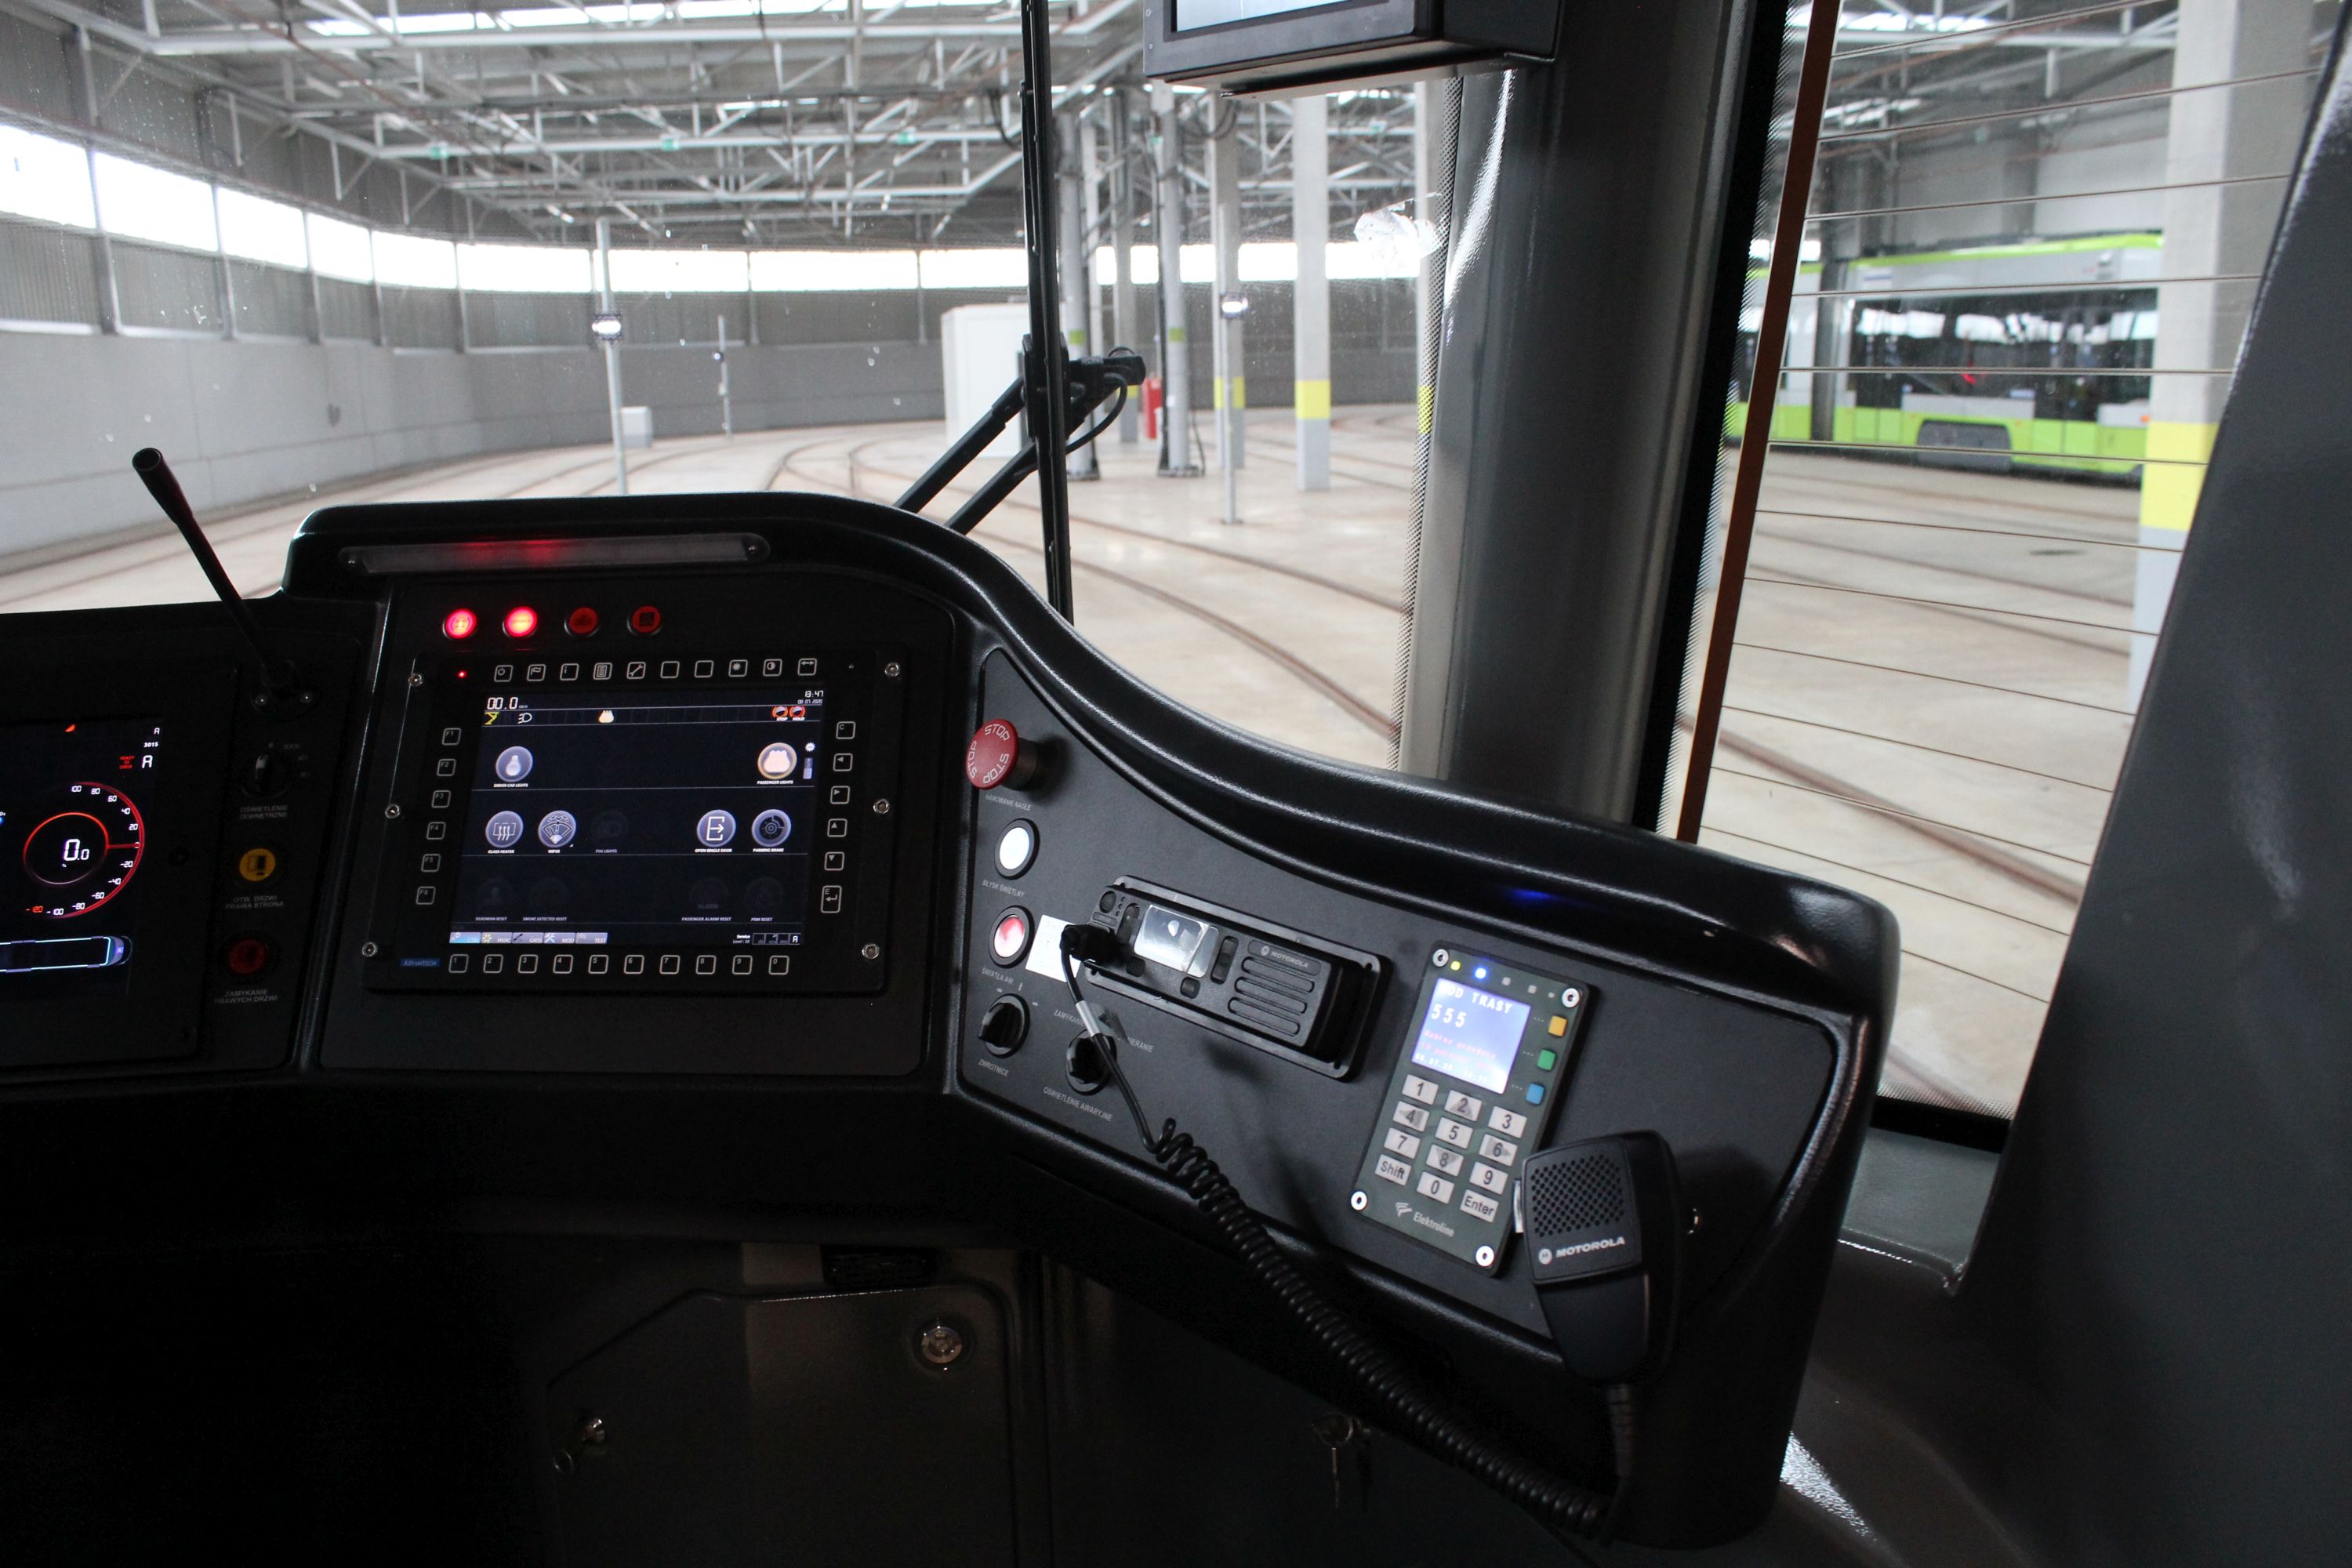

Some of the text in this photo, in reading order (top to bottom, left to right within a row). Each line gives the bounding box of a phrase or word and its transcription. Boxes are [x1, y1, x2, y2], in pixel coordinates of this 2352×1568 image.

[486, 697, 518, 710] 00.0
[985, 724, 1010, 741] STOP
[141, 755, 154, 769] A
[967, 740, 978, 779] STOP
[983, 753, 1009, 784] STOP
[63, 838, 90, 862] 0.0
[1272, 951, 1308, 968] MOTOROLA
[213, 994, 278, 1004] PRAWYCH DRZWI
[224, 989, 268, 997] ZAMYKANIE
[1472, 992, 1513, 1014] TRASY
[1431, 1004, 1467, 1028] 555
[978, 1058, 1010, 1077] ZWROTNICE
[1417, 1082, 1424, 1096] 1
[1080, 1102, 1112, 1122] AWARYJNE
[1457, 1098, 1468, 1113] 2
[1406, 1109, 1416, 1123] 4
[1501, 1114, 1512, 1129] 3
[1449, 1126, 1460, 1140] 5
[1397, 1135, 1407, 1149] 7
[1493, 1142, 1503, 1156] 6
[1439, 1152, 1449, 1167] 8
[1380, 1160, 1405, 1180] Shift
[1483, 1170, 1494, 1185] 9
[1431, 1180, 1440, 1195] 0
[1464, 1196, 1494, 1216] Enter
[1413, 1212, 1454, 1237] Elektroline
[1555, 1236, 1625, 1258] MOTOROLA
